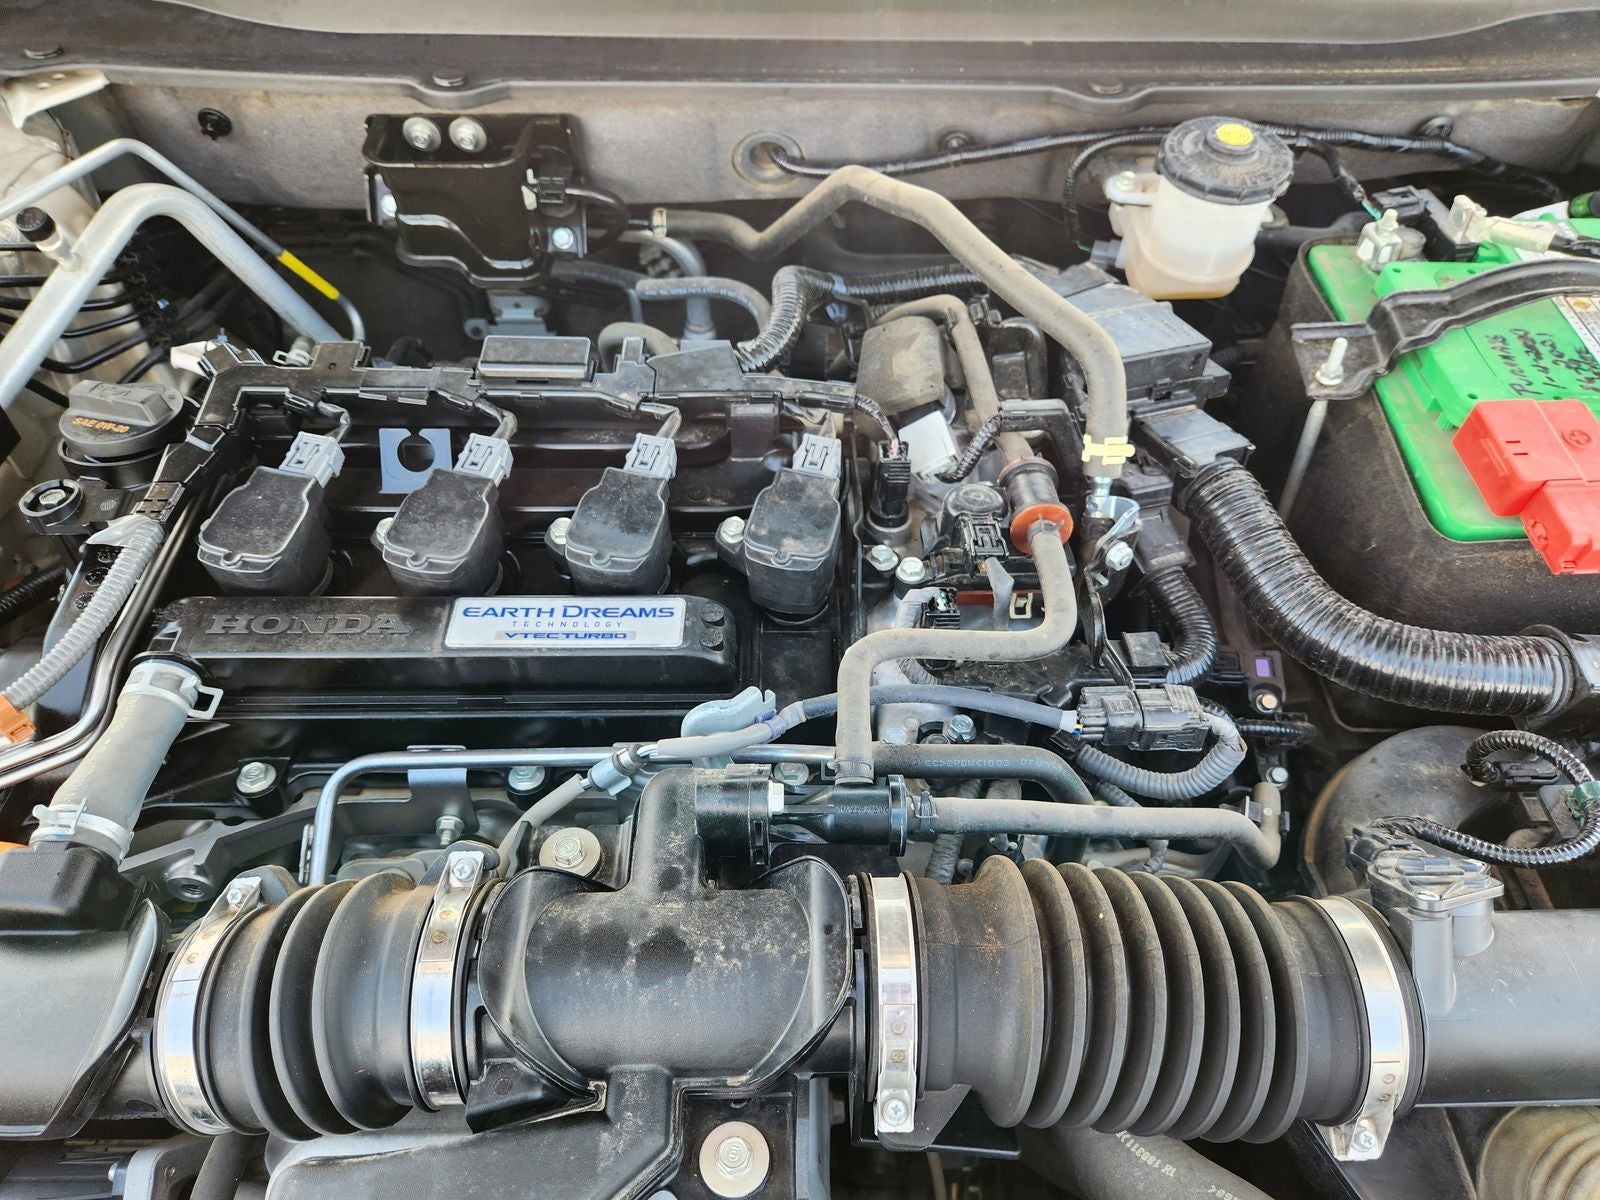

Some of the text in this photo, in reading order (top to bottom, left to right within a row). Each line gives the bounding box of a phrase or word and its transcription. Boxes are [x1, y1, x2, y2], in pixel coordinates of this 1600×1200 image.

[73, 417, 130, 433] SAE 0W-20
[463, 605, 674, 618] EARTH DREAMS
[205, 614, 411, 635] HONDA
